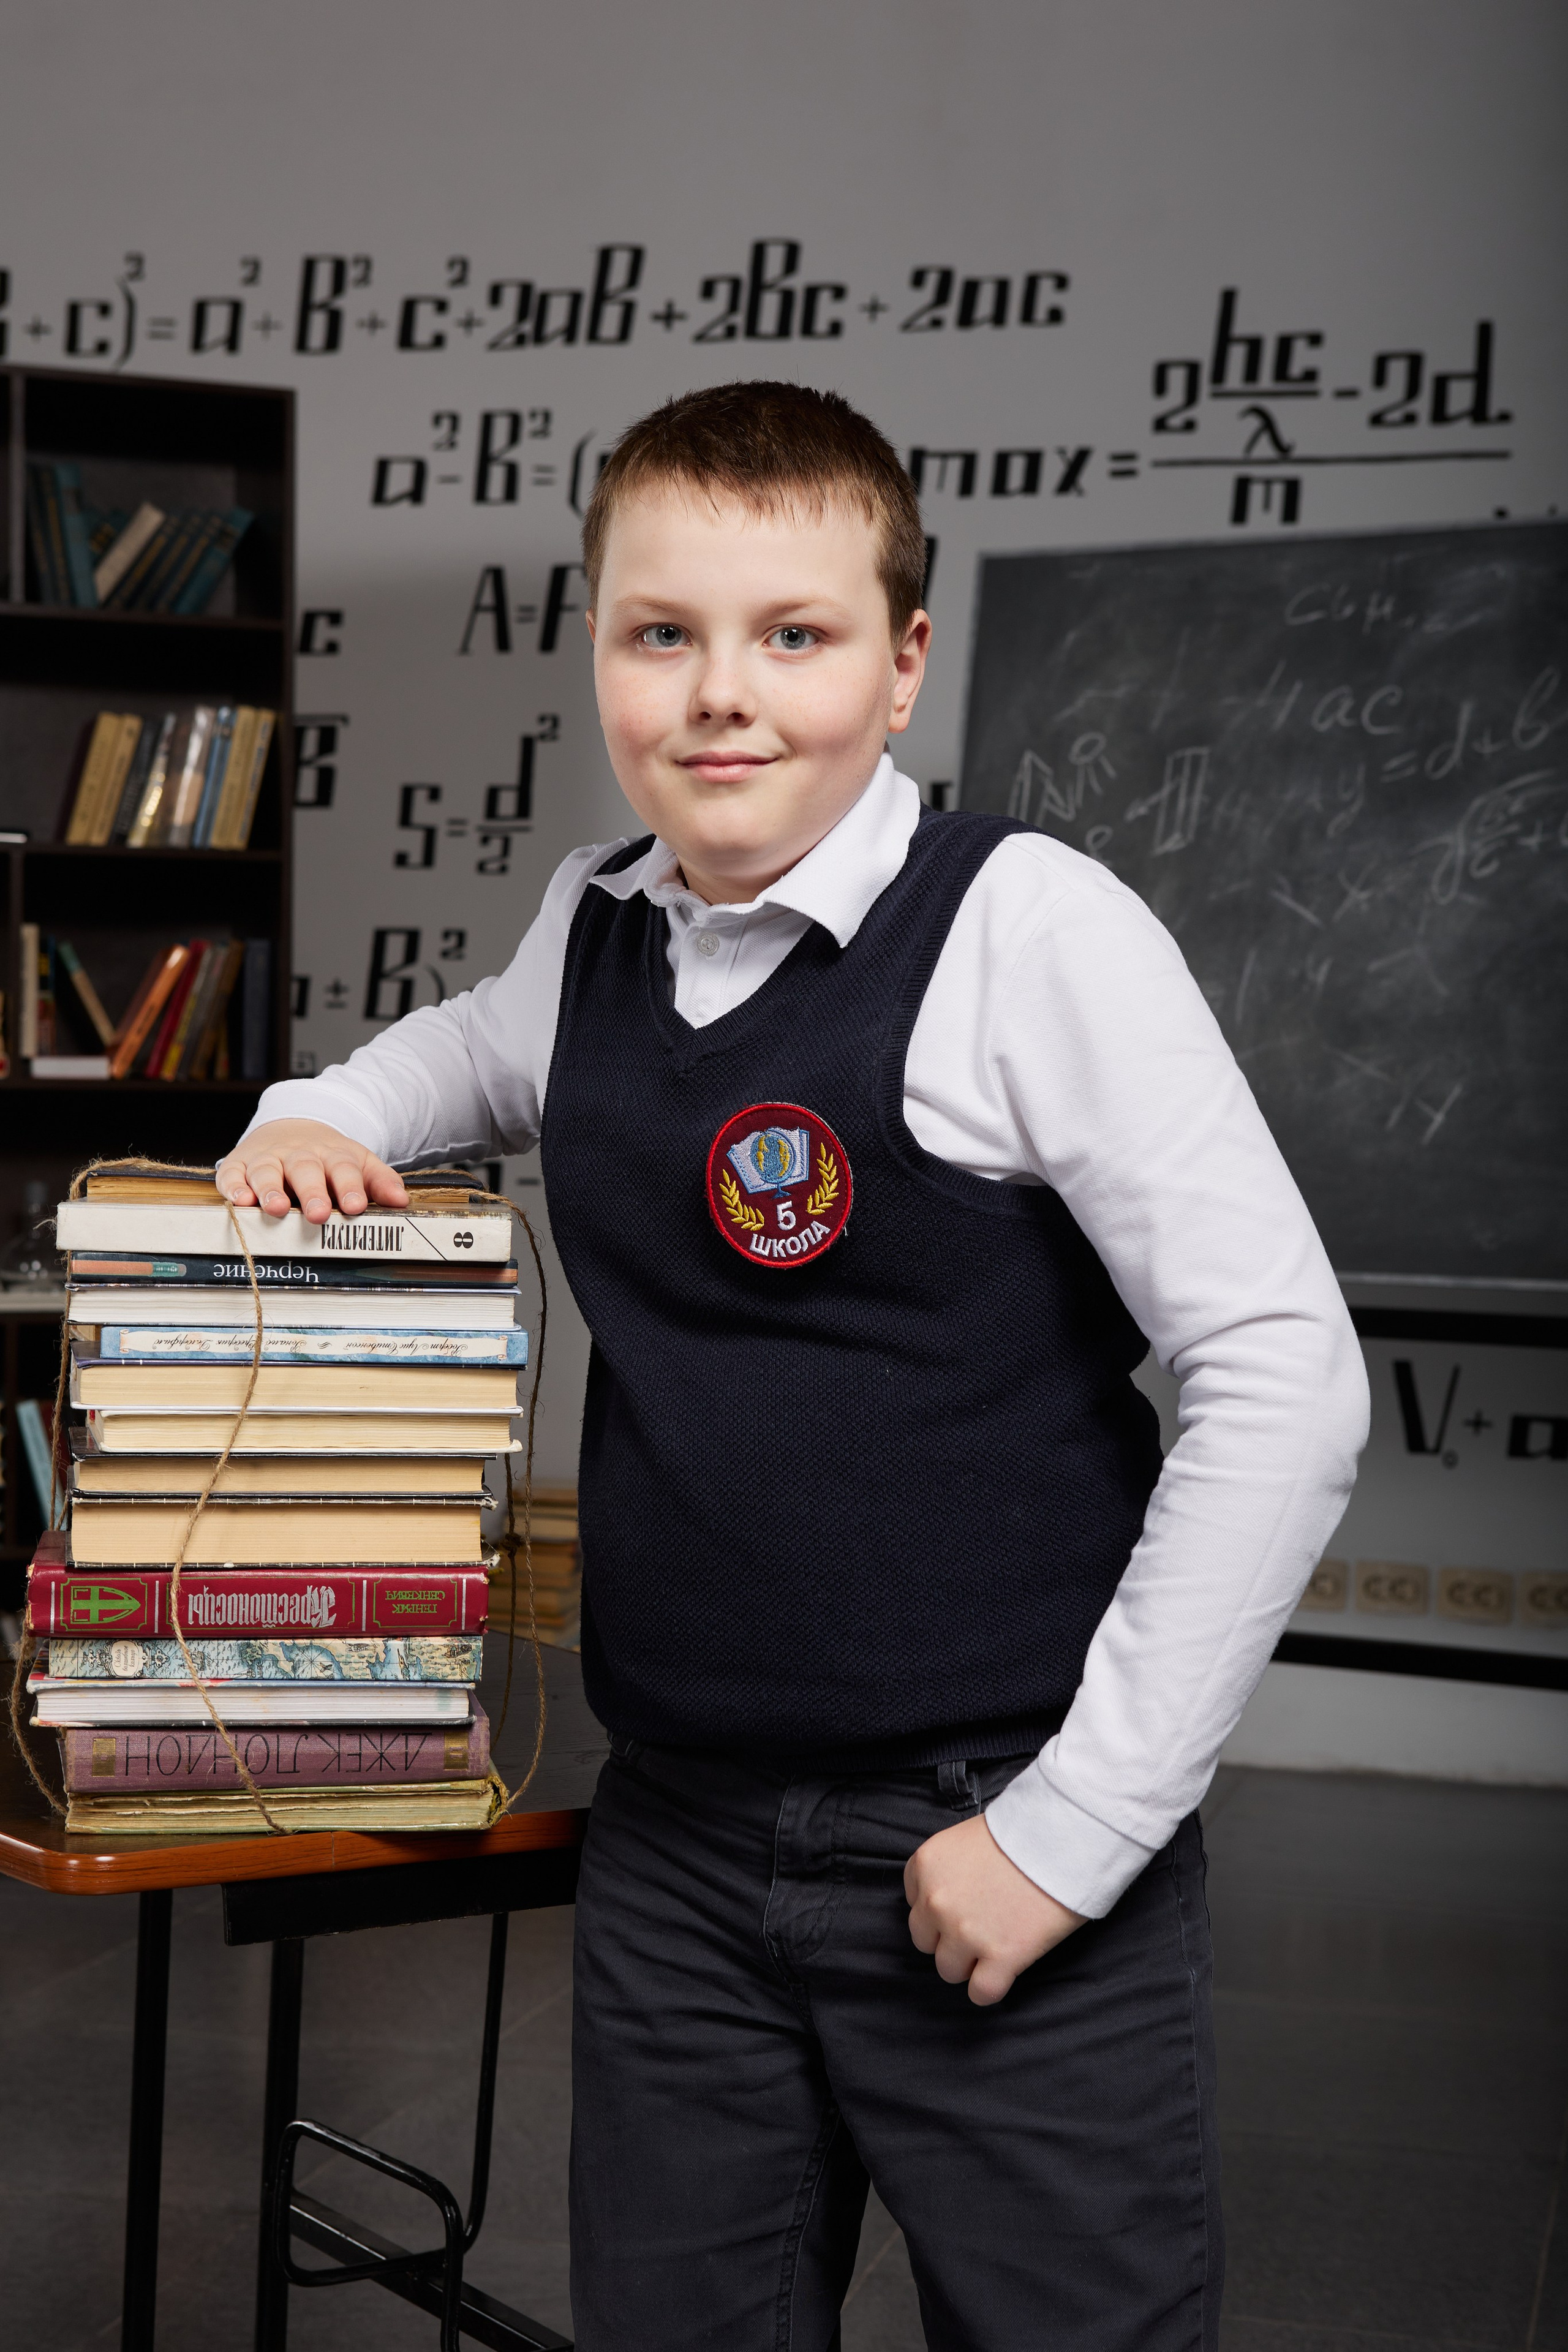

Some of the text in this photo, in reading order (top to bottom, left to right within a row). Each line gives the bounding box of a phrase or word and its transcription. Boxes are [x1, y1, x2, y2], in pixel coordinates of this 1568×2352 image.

[776, 1200, 796, 1231] 5
[321, 1223, 474, 1251] 8 ЛИТЕРАТУРА
[749, 1220, 831, 1258] ШКОЛА
[213, 1261, 320, 1283] Черчение
[153, 1333, 214, 1351] Делдерфилд
[263, 1338, 307, 1352] Рональд
[344, 1340, 399, 1356] Стивенсон
[399, 1338, 429, 1356] Луис
[430, 1338, 469, 1357] Роберт
[385, 1590, 446, 1600] СЕНКЕВИЧ
[188, 1585, 336, 1628] Крестоносцы
[392, 1604, 437, 1614] ГЕНРИК
[124, 1732, 432, 1776] ДЖЕК ЛОНДОН
